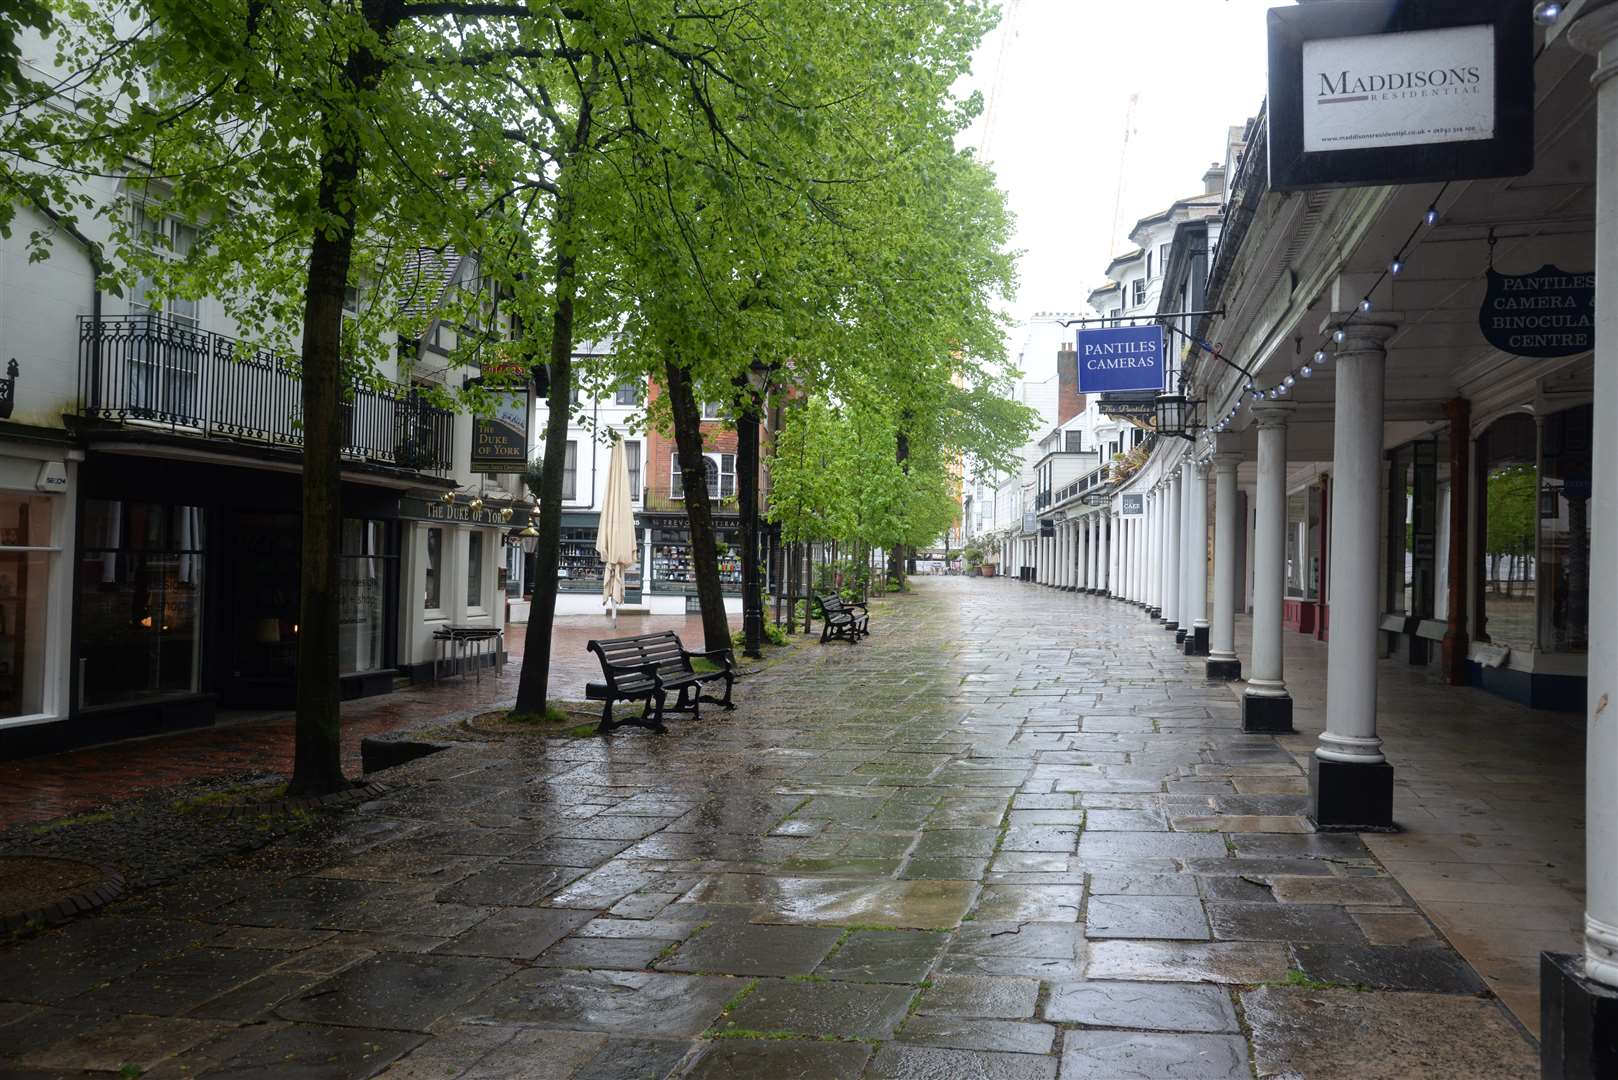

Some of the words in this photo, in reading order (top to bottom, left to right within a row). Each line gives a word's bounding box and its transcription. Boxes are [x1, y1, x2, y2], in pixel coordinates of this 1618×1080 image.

[1318, 66, 1480, 97] MADDISONS
[1371, 85, 1480, 102] RESIDENTIAL
[1503, 275, 1596, 290] PANTILES
[1493, 295, 1577, 310] CAMERA
[1491, 313, 1595, 329] BINOCULA
[1085, 340, 1156, 356] PANTILES
[1508, 333, 1588, 348] CENTRE
[1087, 356, 1154, 370] CAMERAS
[479, 433, 508, 445] DUKE
[478, 446, 491, 455] OF
[494, 445, 520, 456] YORK
[427, 502, 443, 518] THE
[447, 505, 470, 521] DUKE
[472, 511, 482, 522] OF
